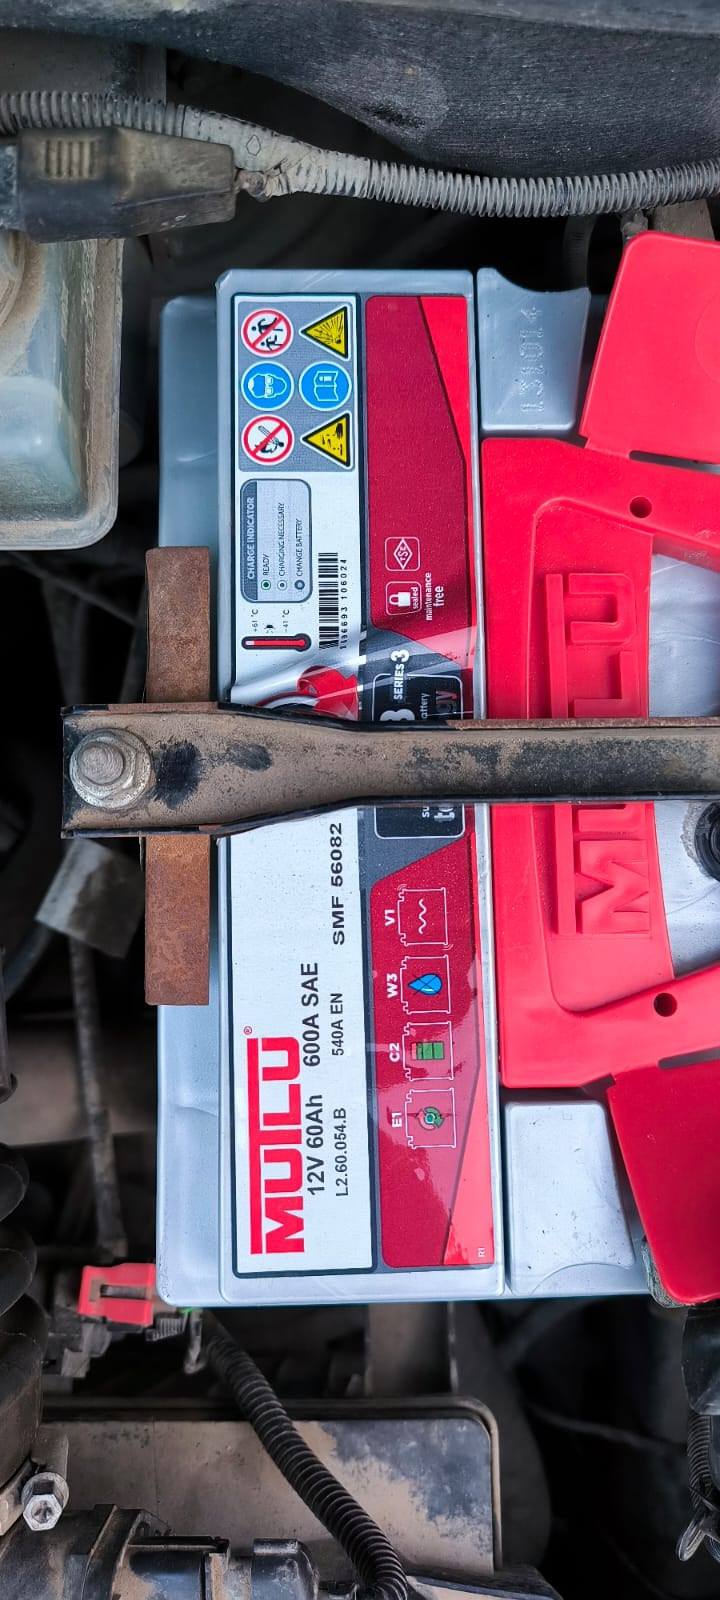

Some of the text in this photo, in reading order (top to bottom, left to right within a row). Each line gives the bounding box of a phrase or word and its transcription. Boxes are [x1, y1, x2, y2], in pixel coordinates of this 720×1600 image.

[246, 497, 255, 579] CHARGE INDICATOR
[295, 519, 303, 577] CHANGE BATTERY
[262, 554, 270, 576] READY
[340, 559, 348, 599] 106024
[411, 587, 419, 609] sealed
[425, 572, 433, 621] maintenance
[433, 586, 445, 607] free
[390, 650, 410, 663] 3
[394, 664, 405, 700] SERIES
[420, 693, 430, 720] attery
[330, 823, 345, 945] SMF 56082
[384, 909, 395, 926] V1
[387, 973, 398, 998] W3
[389, 1042, 400, 1062] C2
[300, 962, 325, 1196] 12V 60Ah 600A SAE
[330, 993, 349, 1197] L2.60.054.B 540A EN
[392, 1112, 403, 1128] E1
[247, 1036, 305, 1254] MUTLU
[477, 1247, 485, 1258] R1
